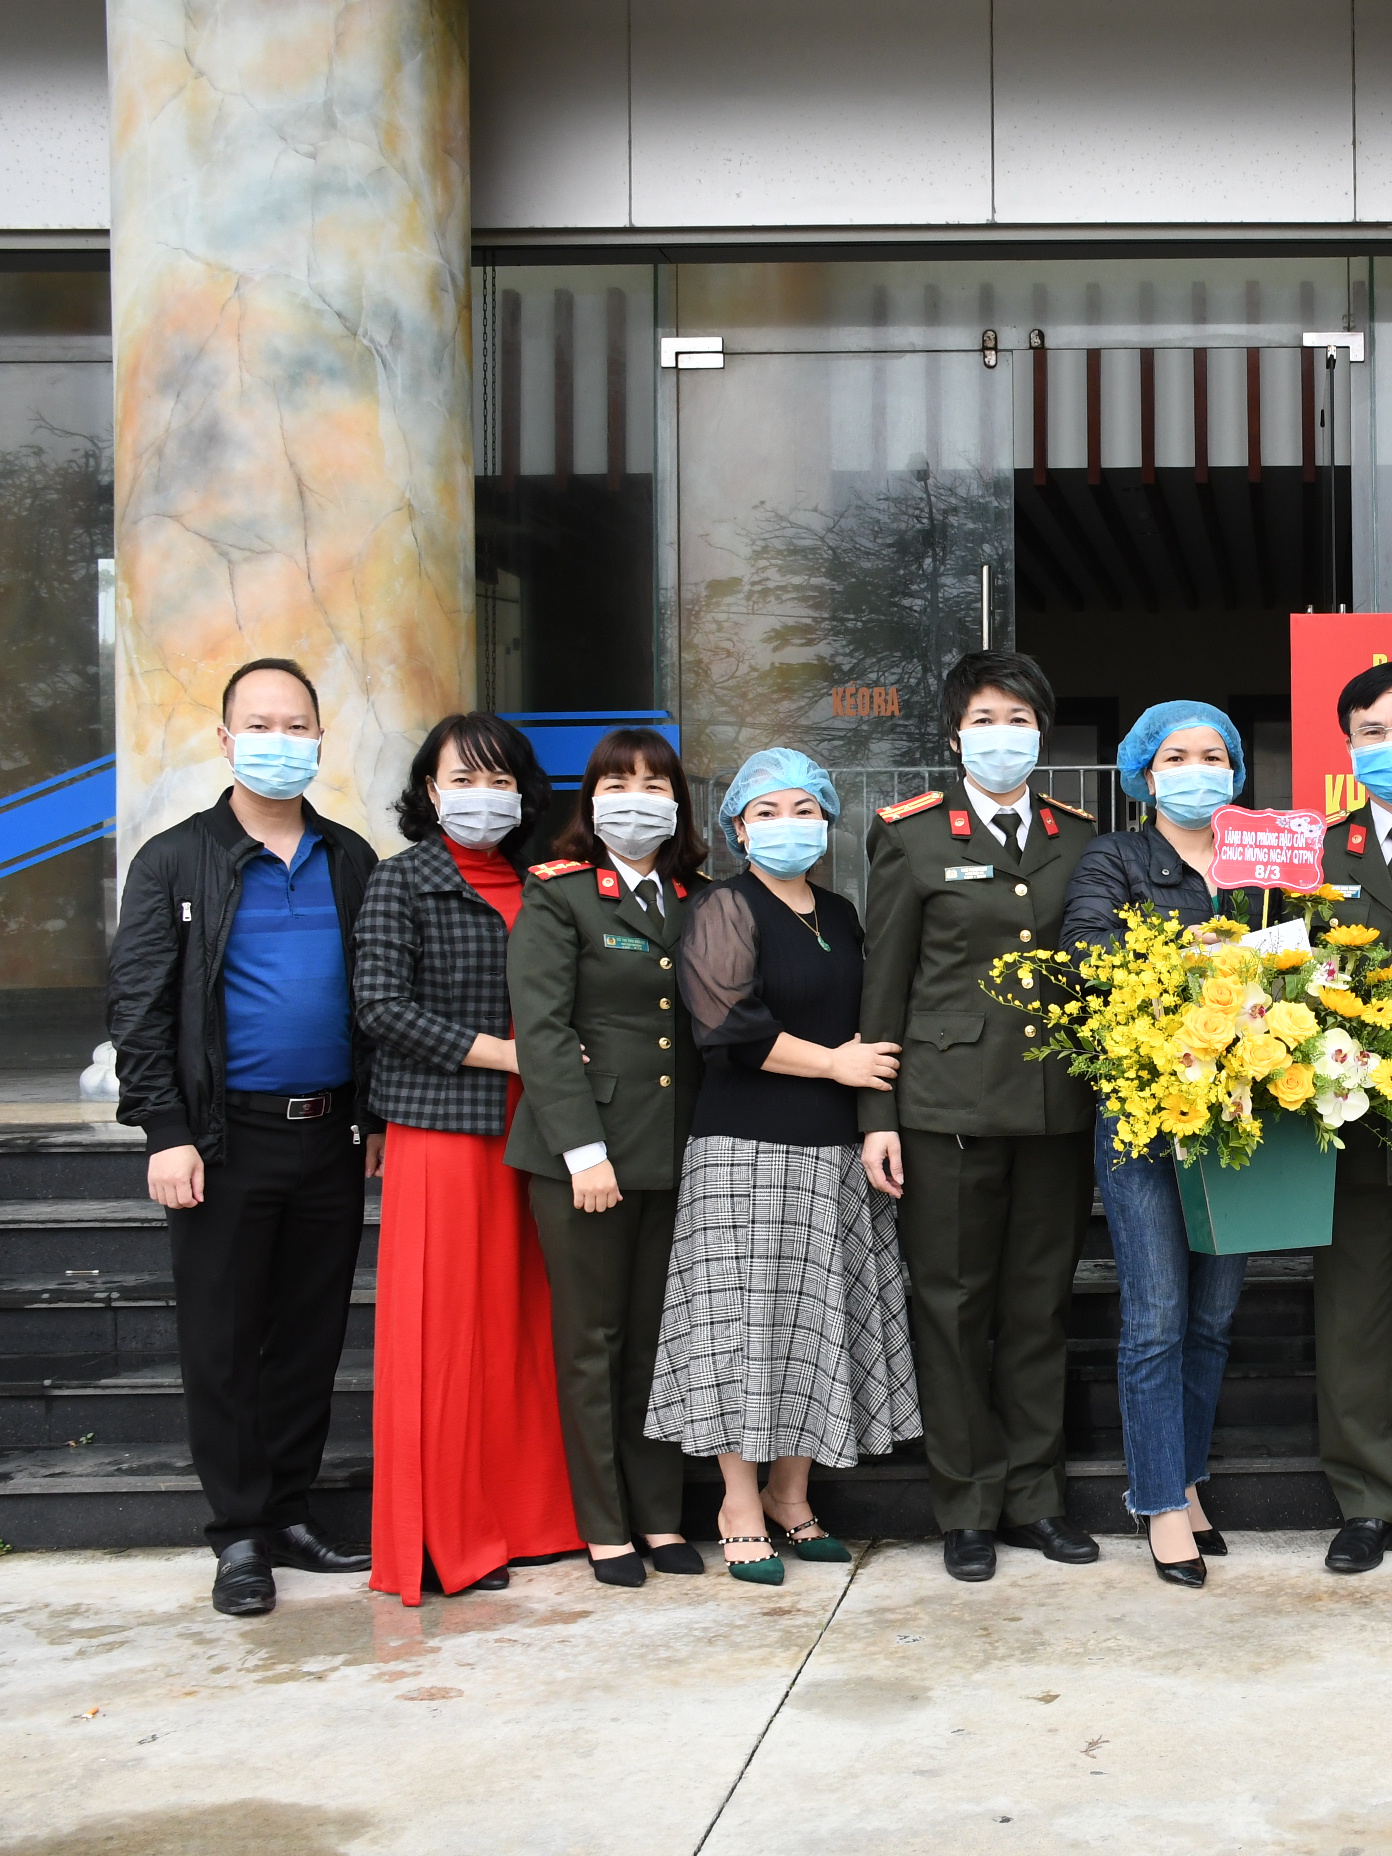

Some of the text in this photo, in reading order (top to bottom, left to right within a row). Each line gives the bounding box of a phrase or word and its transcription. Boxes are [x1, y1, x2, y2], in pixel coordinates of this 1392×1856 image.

[832, 680, 901, 717] KÉO RA
[1221, 844, 1244, 861] CHÚC
[1269, 847, 1292, 863] NGÀY
[1292, 849, 1314, 865] QTPN
[1254, 865, 1280, 880] 8/3
